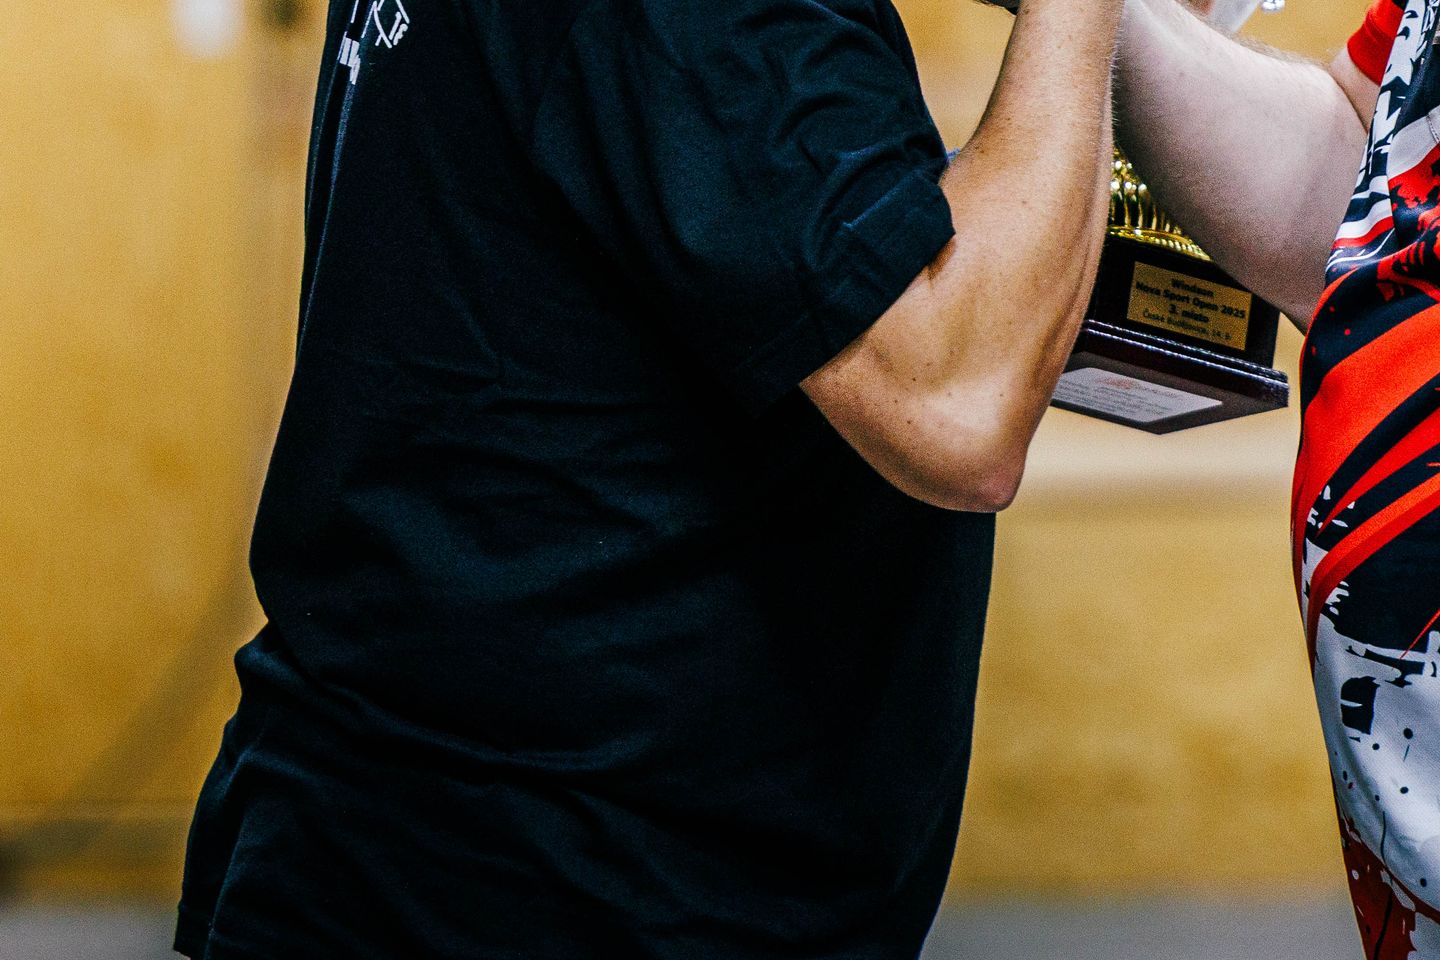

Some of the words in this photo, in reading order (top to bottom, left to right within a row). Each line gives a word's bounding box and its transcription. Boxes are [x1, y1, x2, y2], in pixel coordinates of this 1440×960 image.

[1163, 289, 1190, 304] Sport
[1191, 297, 1219, 312] Open
[1221, 305, 1245, 319] 2025
